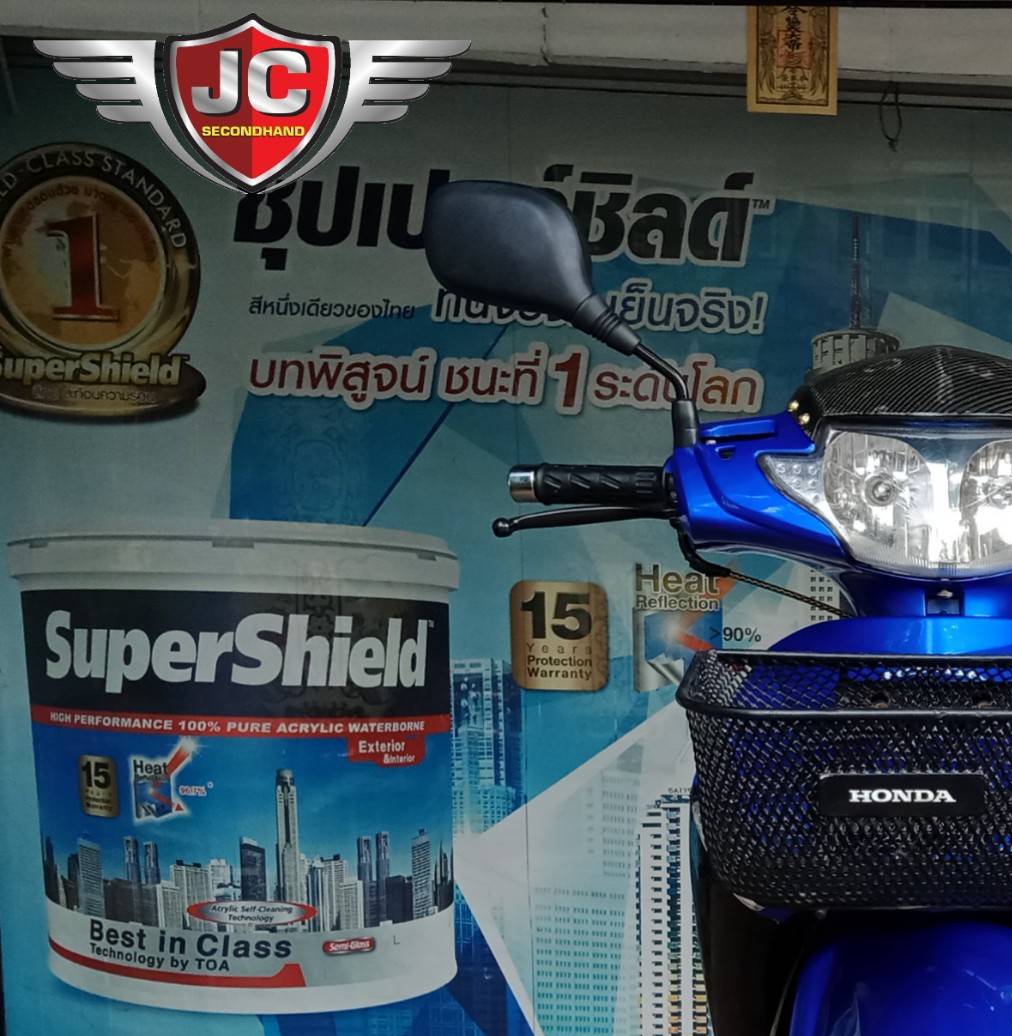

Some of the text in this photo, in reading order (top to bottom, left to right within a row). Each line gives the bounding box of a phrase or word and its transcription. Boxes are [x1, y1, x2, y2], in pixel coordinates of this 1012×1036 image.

[248, 295, 415, 321] สีหนึ่งเดียวของไทย
[249, 352, 428, 402] บทพิสูจน์
[443, 350, 541, 399] ชนะที่
[553, 353, 585, 408] 1
[635, 562, 719, 595] Heat
[635, 594, 719, 610] Reflection
[520, 591, 592, 640] 15
[45, 608, 428, 694] SuperShield
[526, 642, 592, 655] Years
[526, 655, 592, 668] Protection
[526, 667, 592, 681] Warranty
[50, 711, 425, 734] HIGH PERFORMANCE 100% PURE ACRYLIC WATERBORNE
[358, 738, 406, 753] Exterior
[81, 760, 111, 789] 15
[133, 759, 169, 775] Heat
[848, 788, 957, 803] HONDA
[89, 918, 292, 959] Best in Class
[90, 942, 230, 972] Technology by TOA
